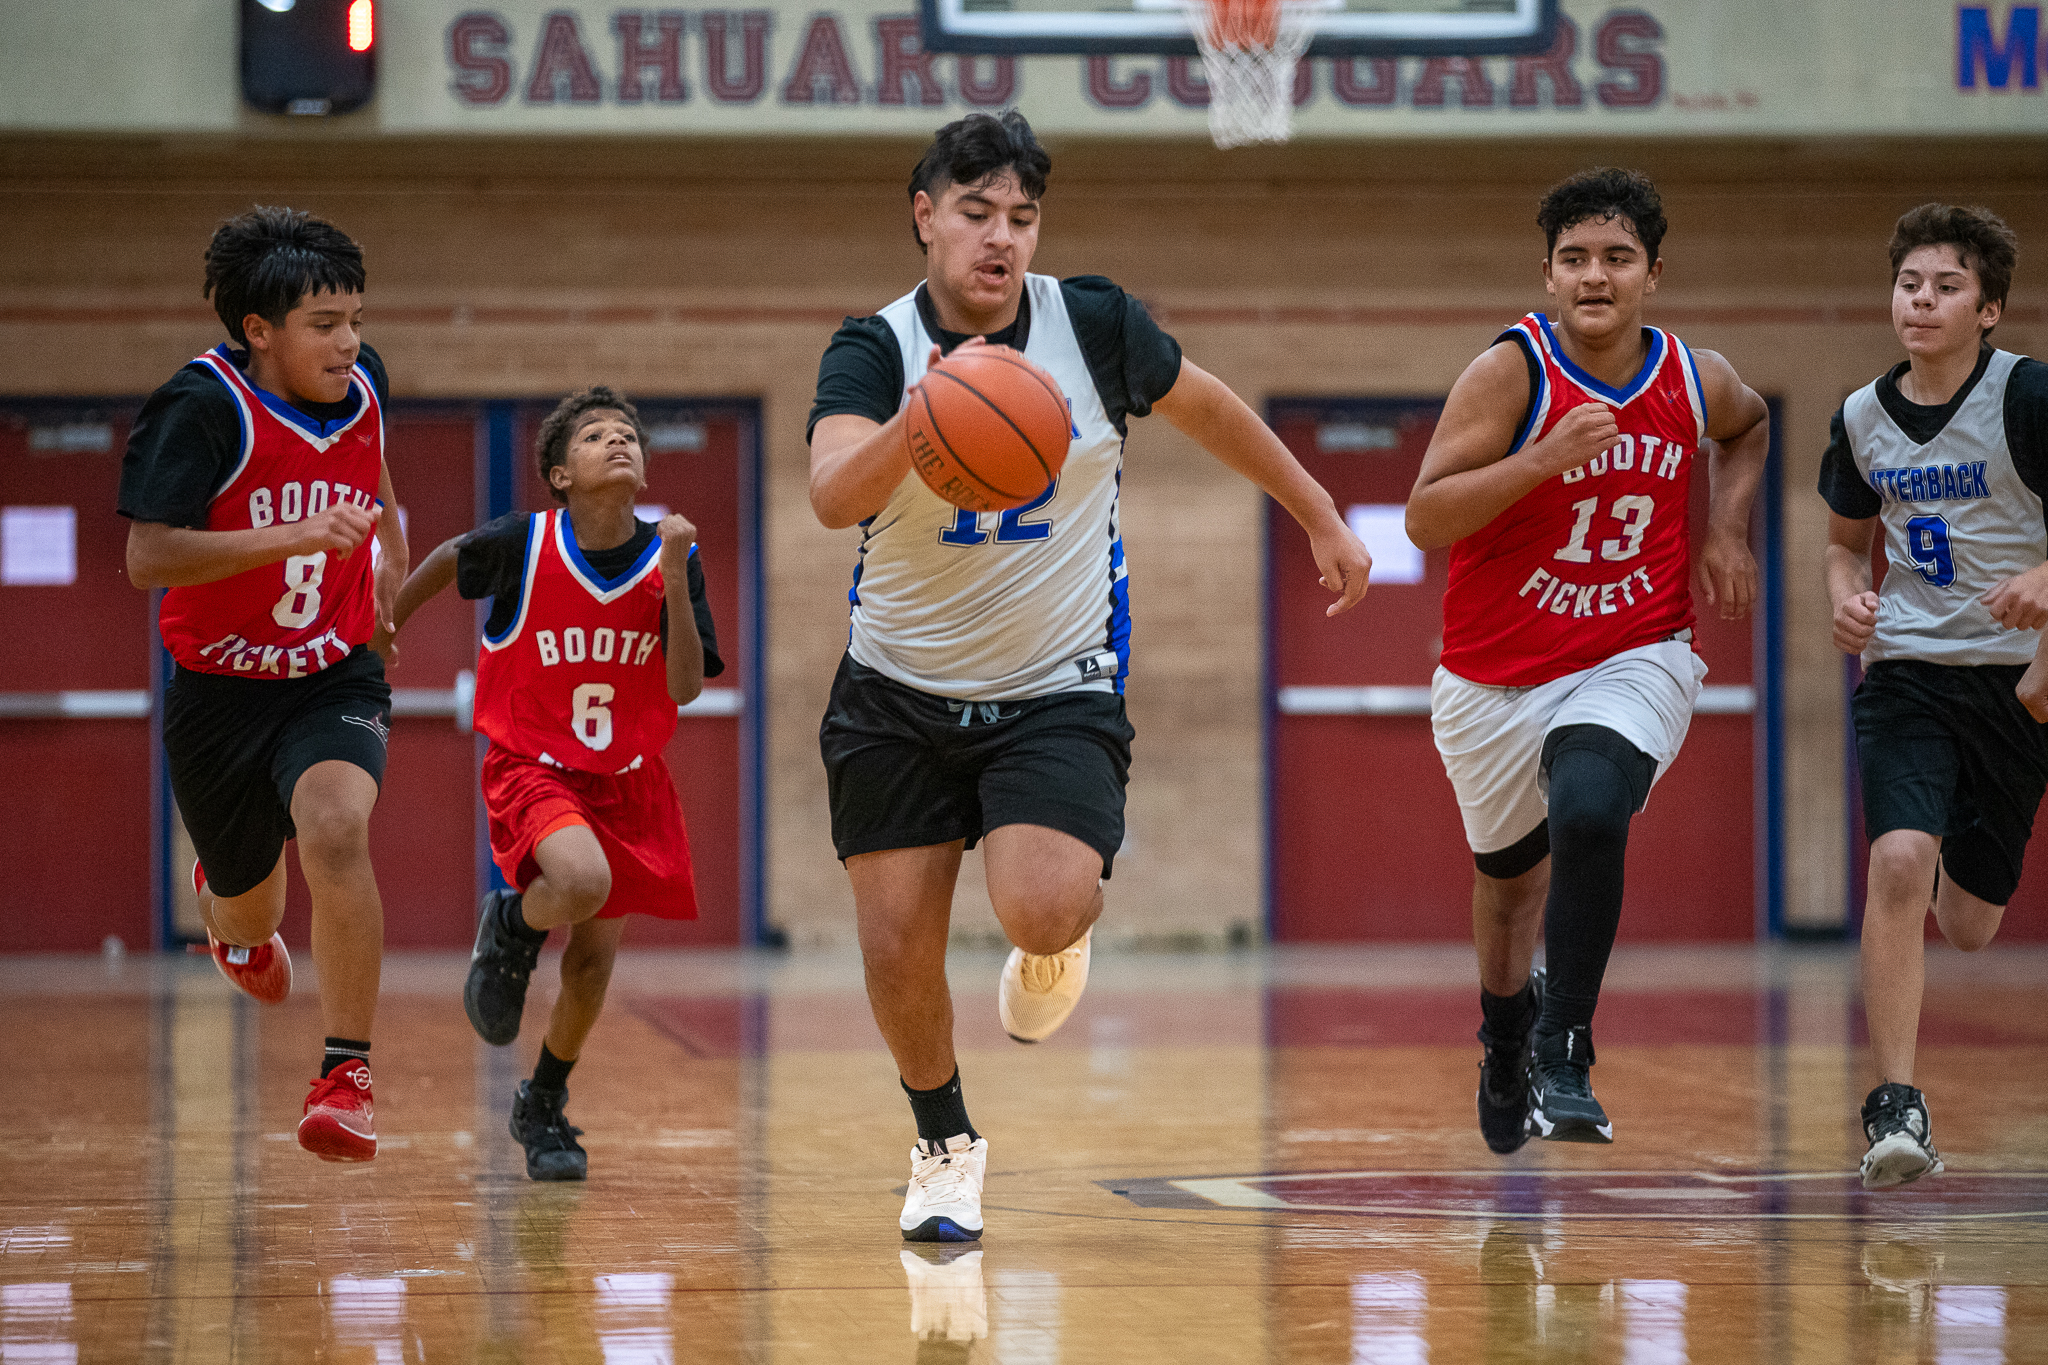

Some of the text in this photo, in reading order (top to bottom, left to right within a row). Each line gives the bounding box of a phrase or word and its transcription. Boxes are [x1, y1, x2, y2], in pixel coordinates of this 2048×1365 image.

[444, 10, 1664, 107] SAHUARO CGARS
[912, 427, 945, 476] THE
[1553, 494, 1655, 563] 13
[1903, 513, 1957, 588] 9
[271, 550, 327, 630] 8
[1518, 565, 1654, 618] FICKETT
[199, 627, 351, 679] FICKETT
[535, 626, 660, 667] BOOTH
[570, 683, 616, 751] 6
